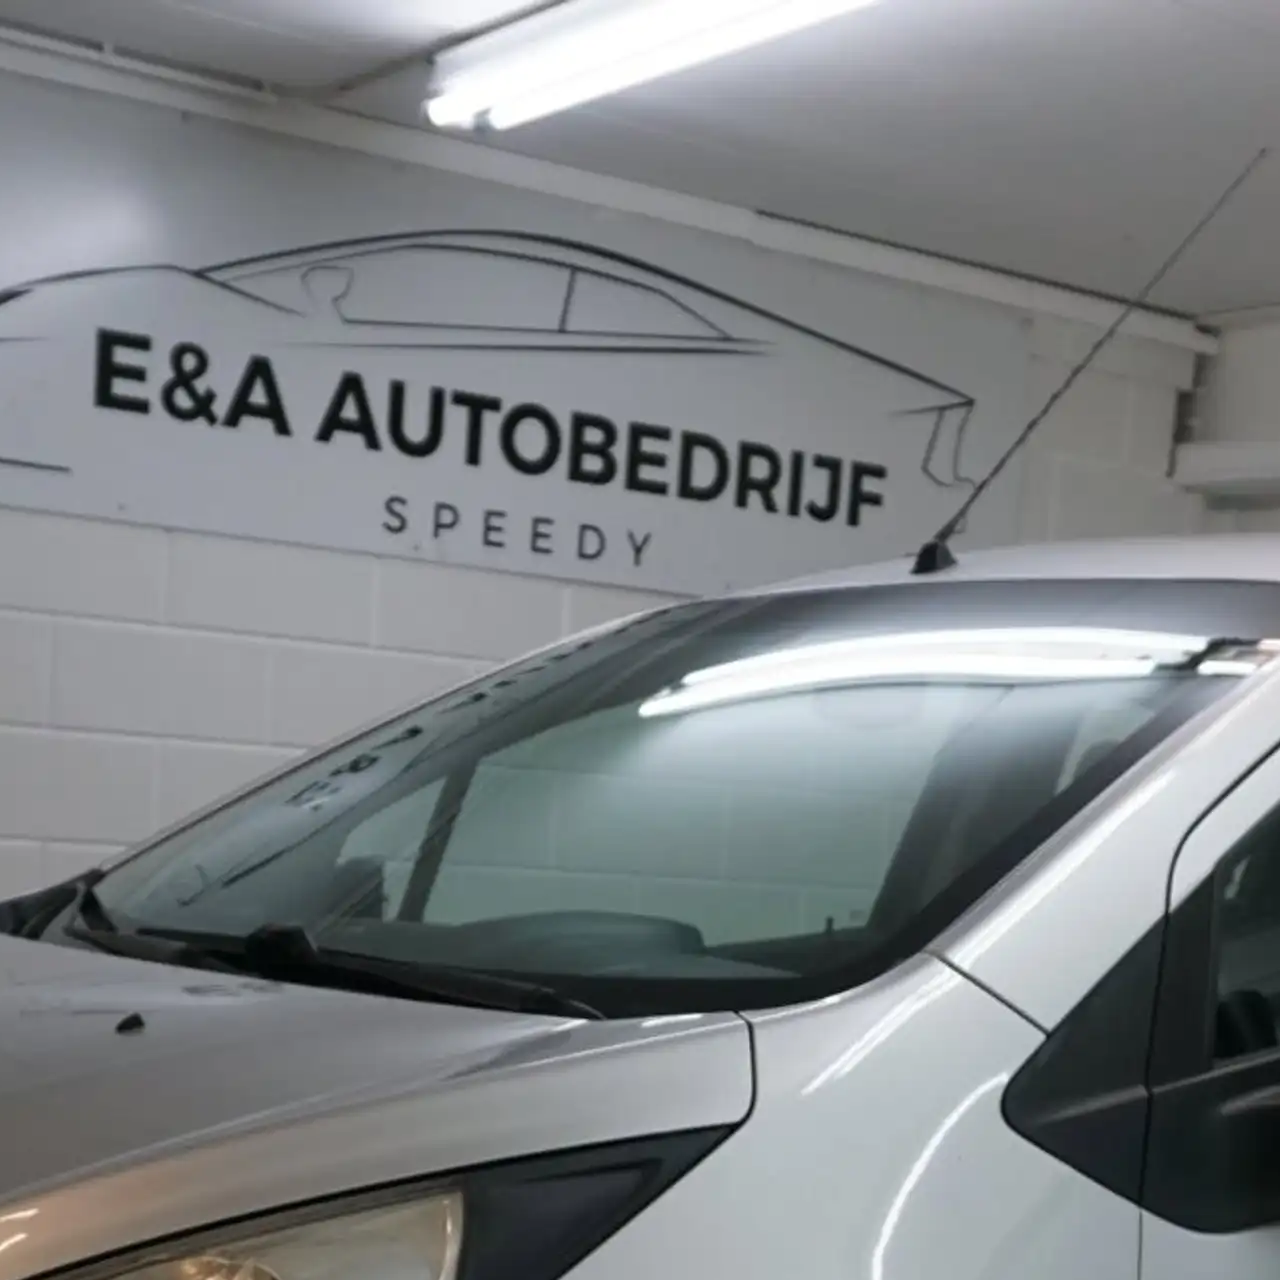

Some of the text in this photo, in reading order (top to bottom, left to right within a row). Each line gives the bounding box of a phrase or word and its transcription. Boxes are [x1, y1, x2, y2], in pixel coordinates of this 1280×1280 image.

[93, 328, 887, 528] E&A AUTOBEDRIJF
[382, 496, 653, 567] SPEEDY
